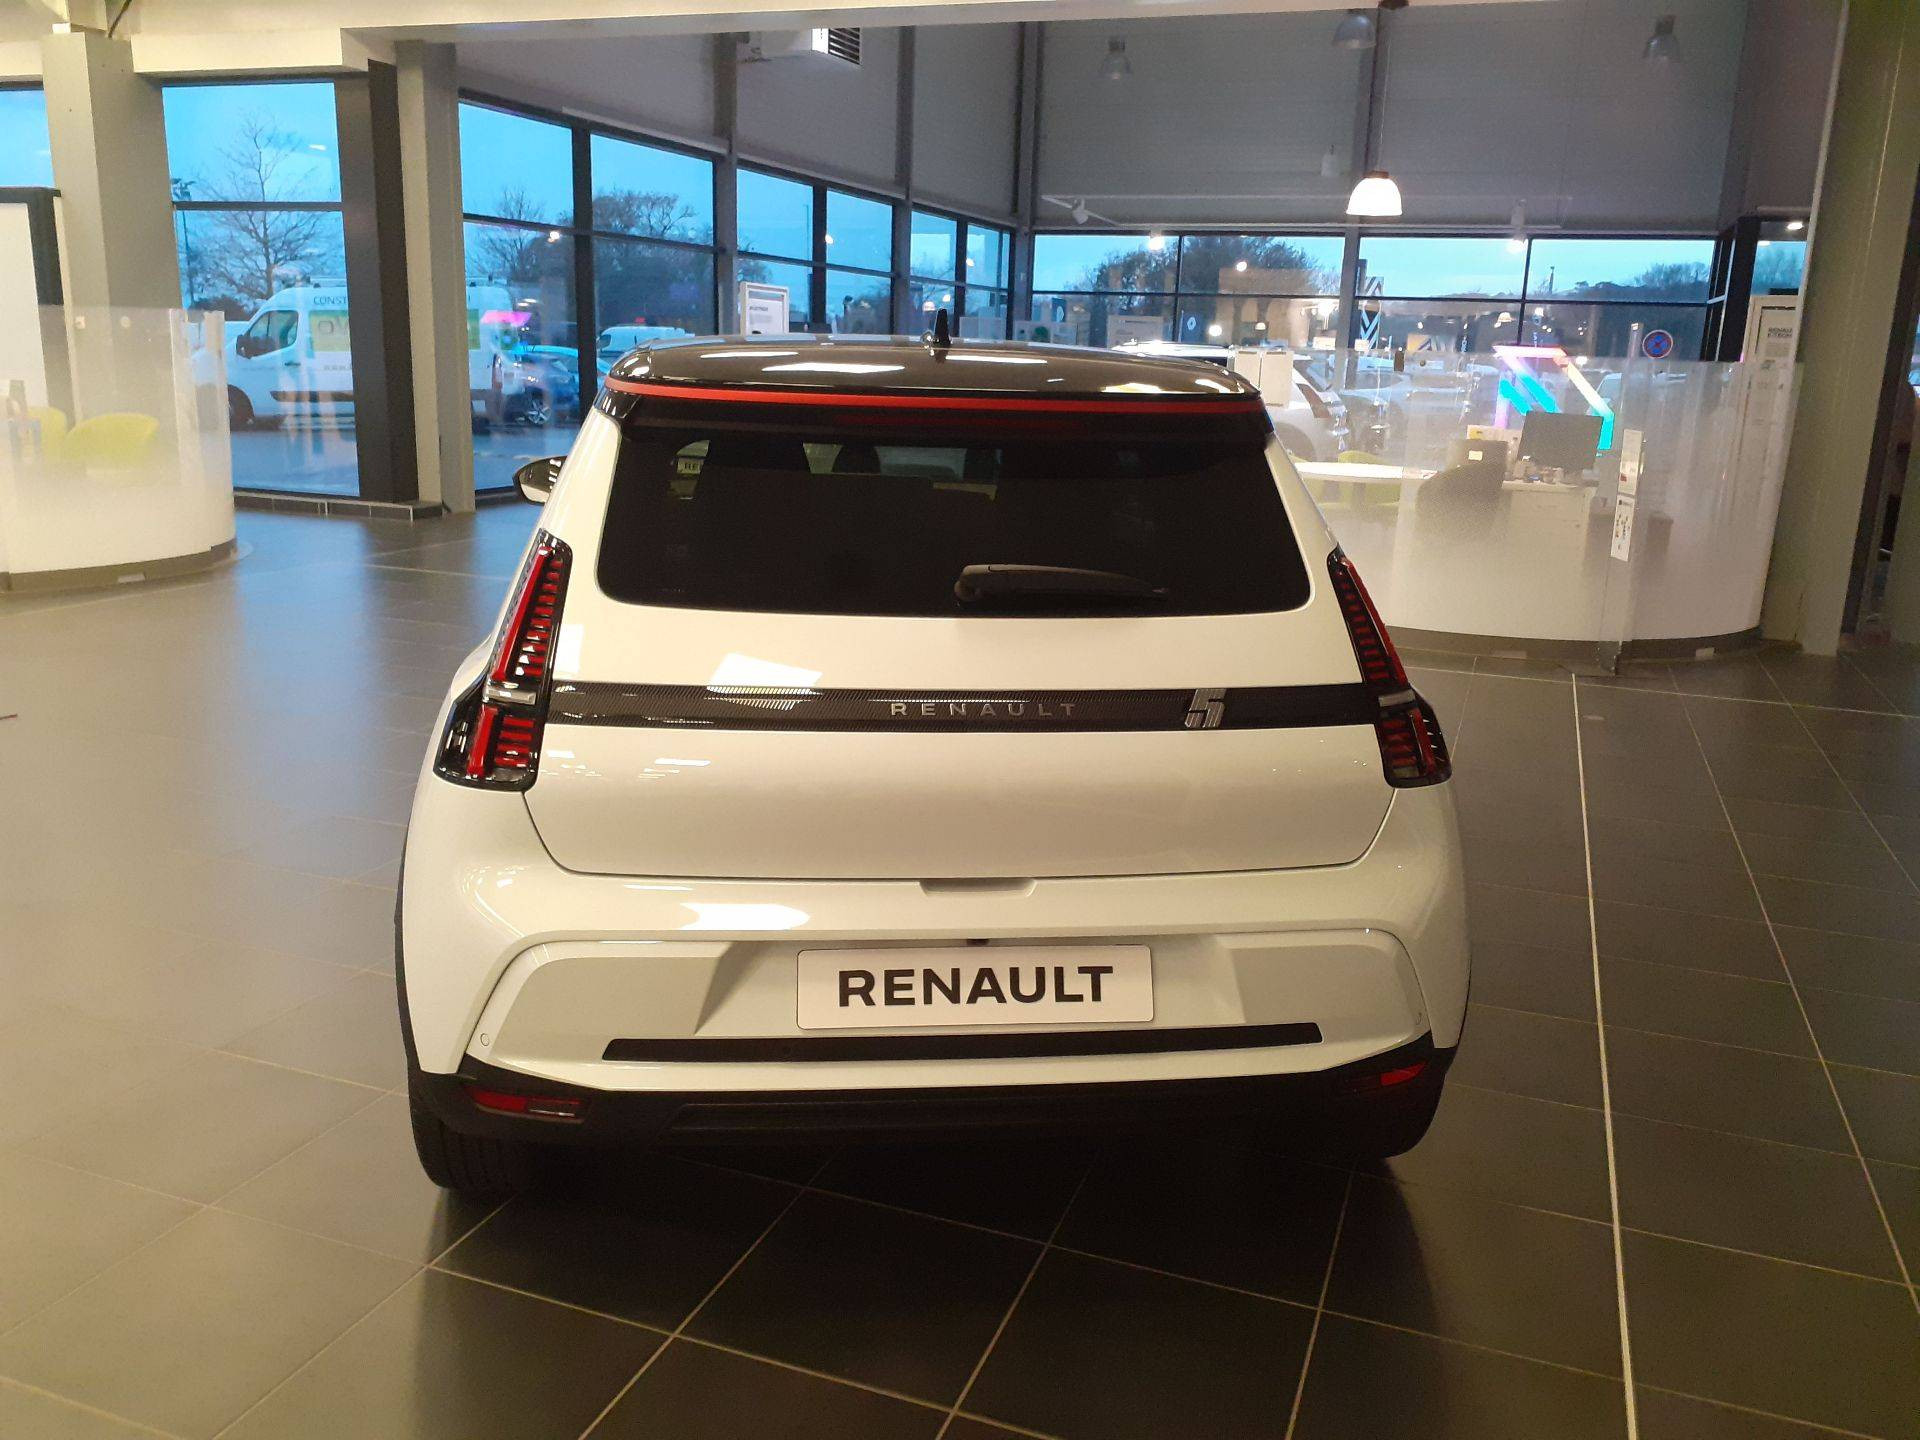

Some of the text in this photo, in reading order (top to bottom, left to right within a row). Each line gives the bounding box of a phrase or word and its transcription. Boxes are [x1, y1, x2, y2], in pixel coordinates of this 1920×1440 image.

[891, 702, 1076, 717] RENAULT
[1184, 688, 1227, 728] 5
[838, 966, 1114, 1008] RENAULT
